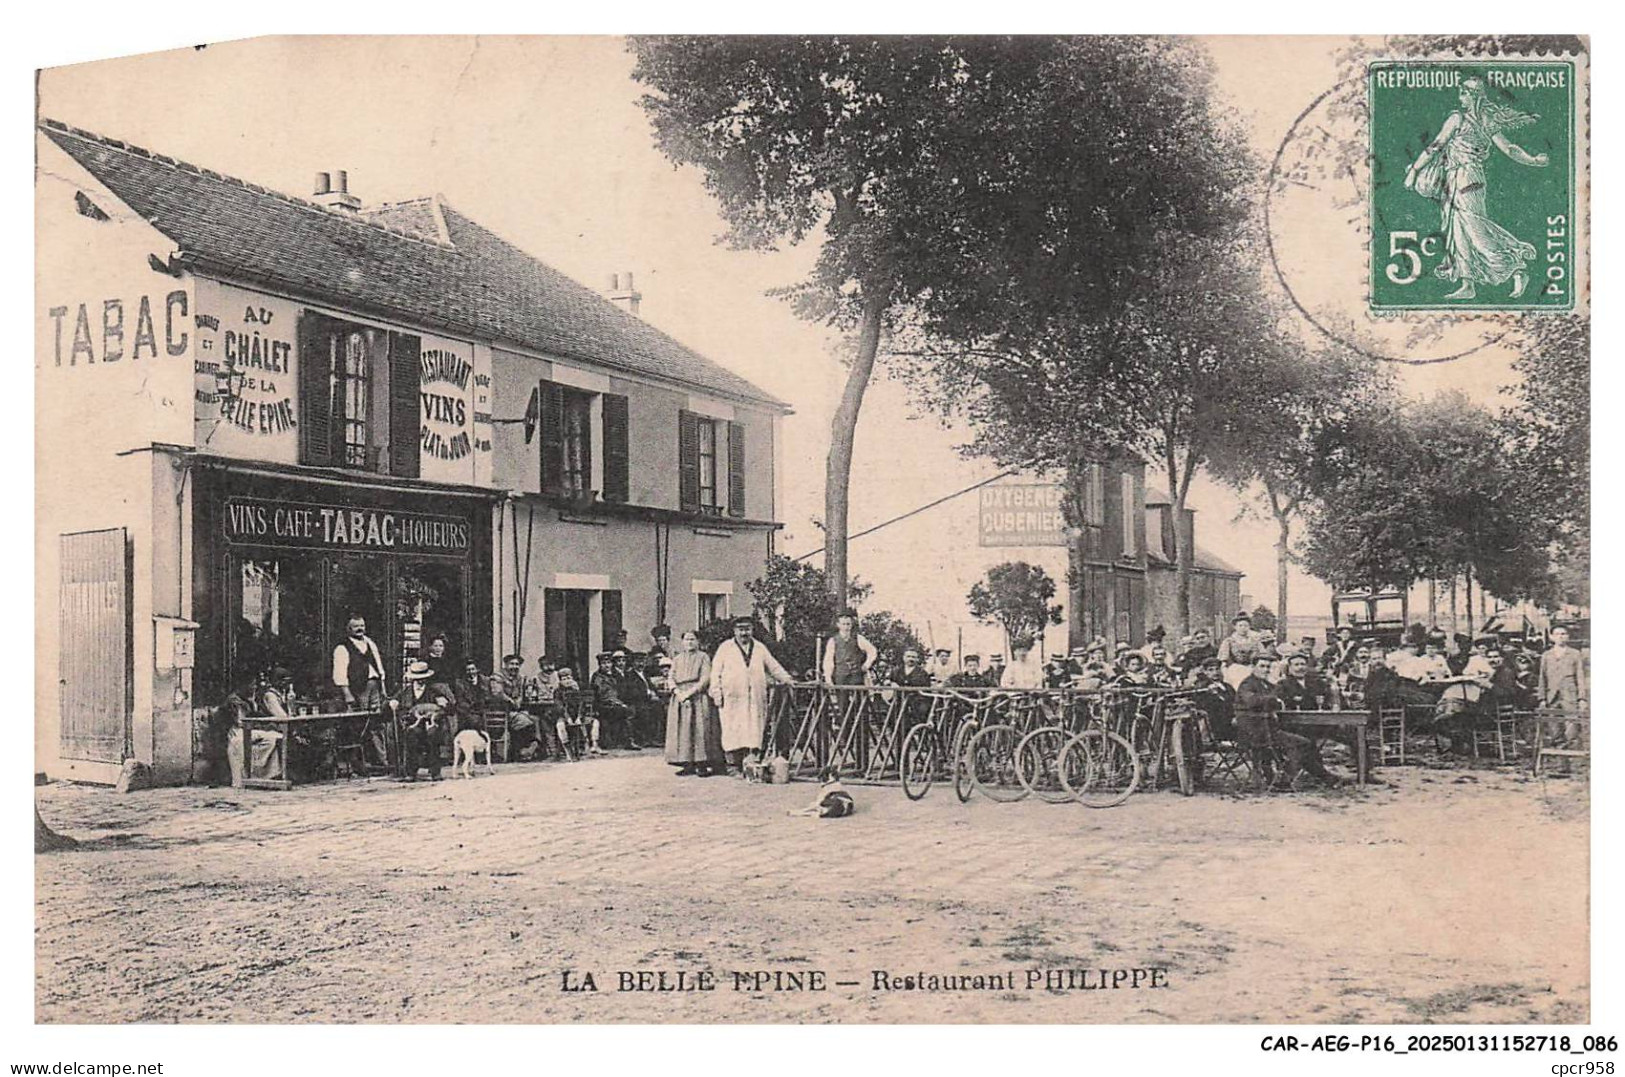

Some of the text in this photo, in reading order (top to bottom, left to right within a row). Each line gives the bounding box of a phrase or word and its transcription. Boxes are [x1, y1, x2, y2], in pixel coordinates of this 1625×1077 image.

[1487, 70, 1566, 90] FRANÇAISE
[1547, 214, 1565, 295] POSTES
[49, 289, 188, 367] TABAC
[243, 305, 273, 325] AU
[224, 330, 291, 374] CHÂLET
[241, 378, 276, 394] DE LA
[259, 398, 297, 434] ÉPINE
[421, 392, 465, 427] VINS
[420, 424, 441, 458] PLAT
[449, 431, 472, 460] JOUR
[229, 504, 267, 535] VINS
[320, 509, 395, 546] TABAC
[401, 518, 467, 548] LIQUEURS
